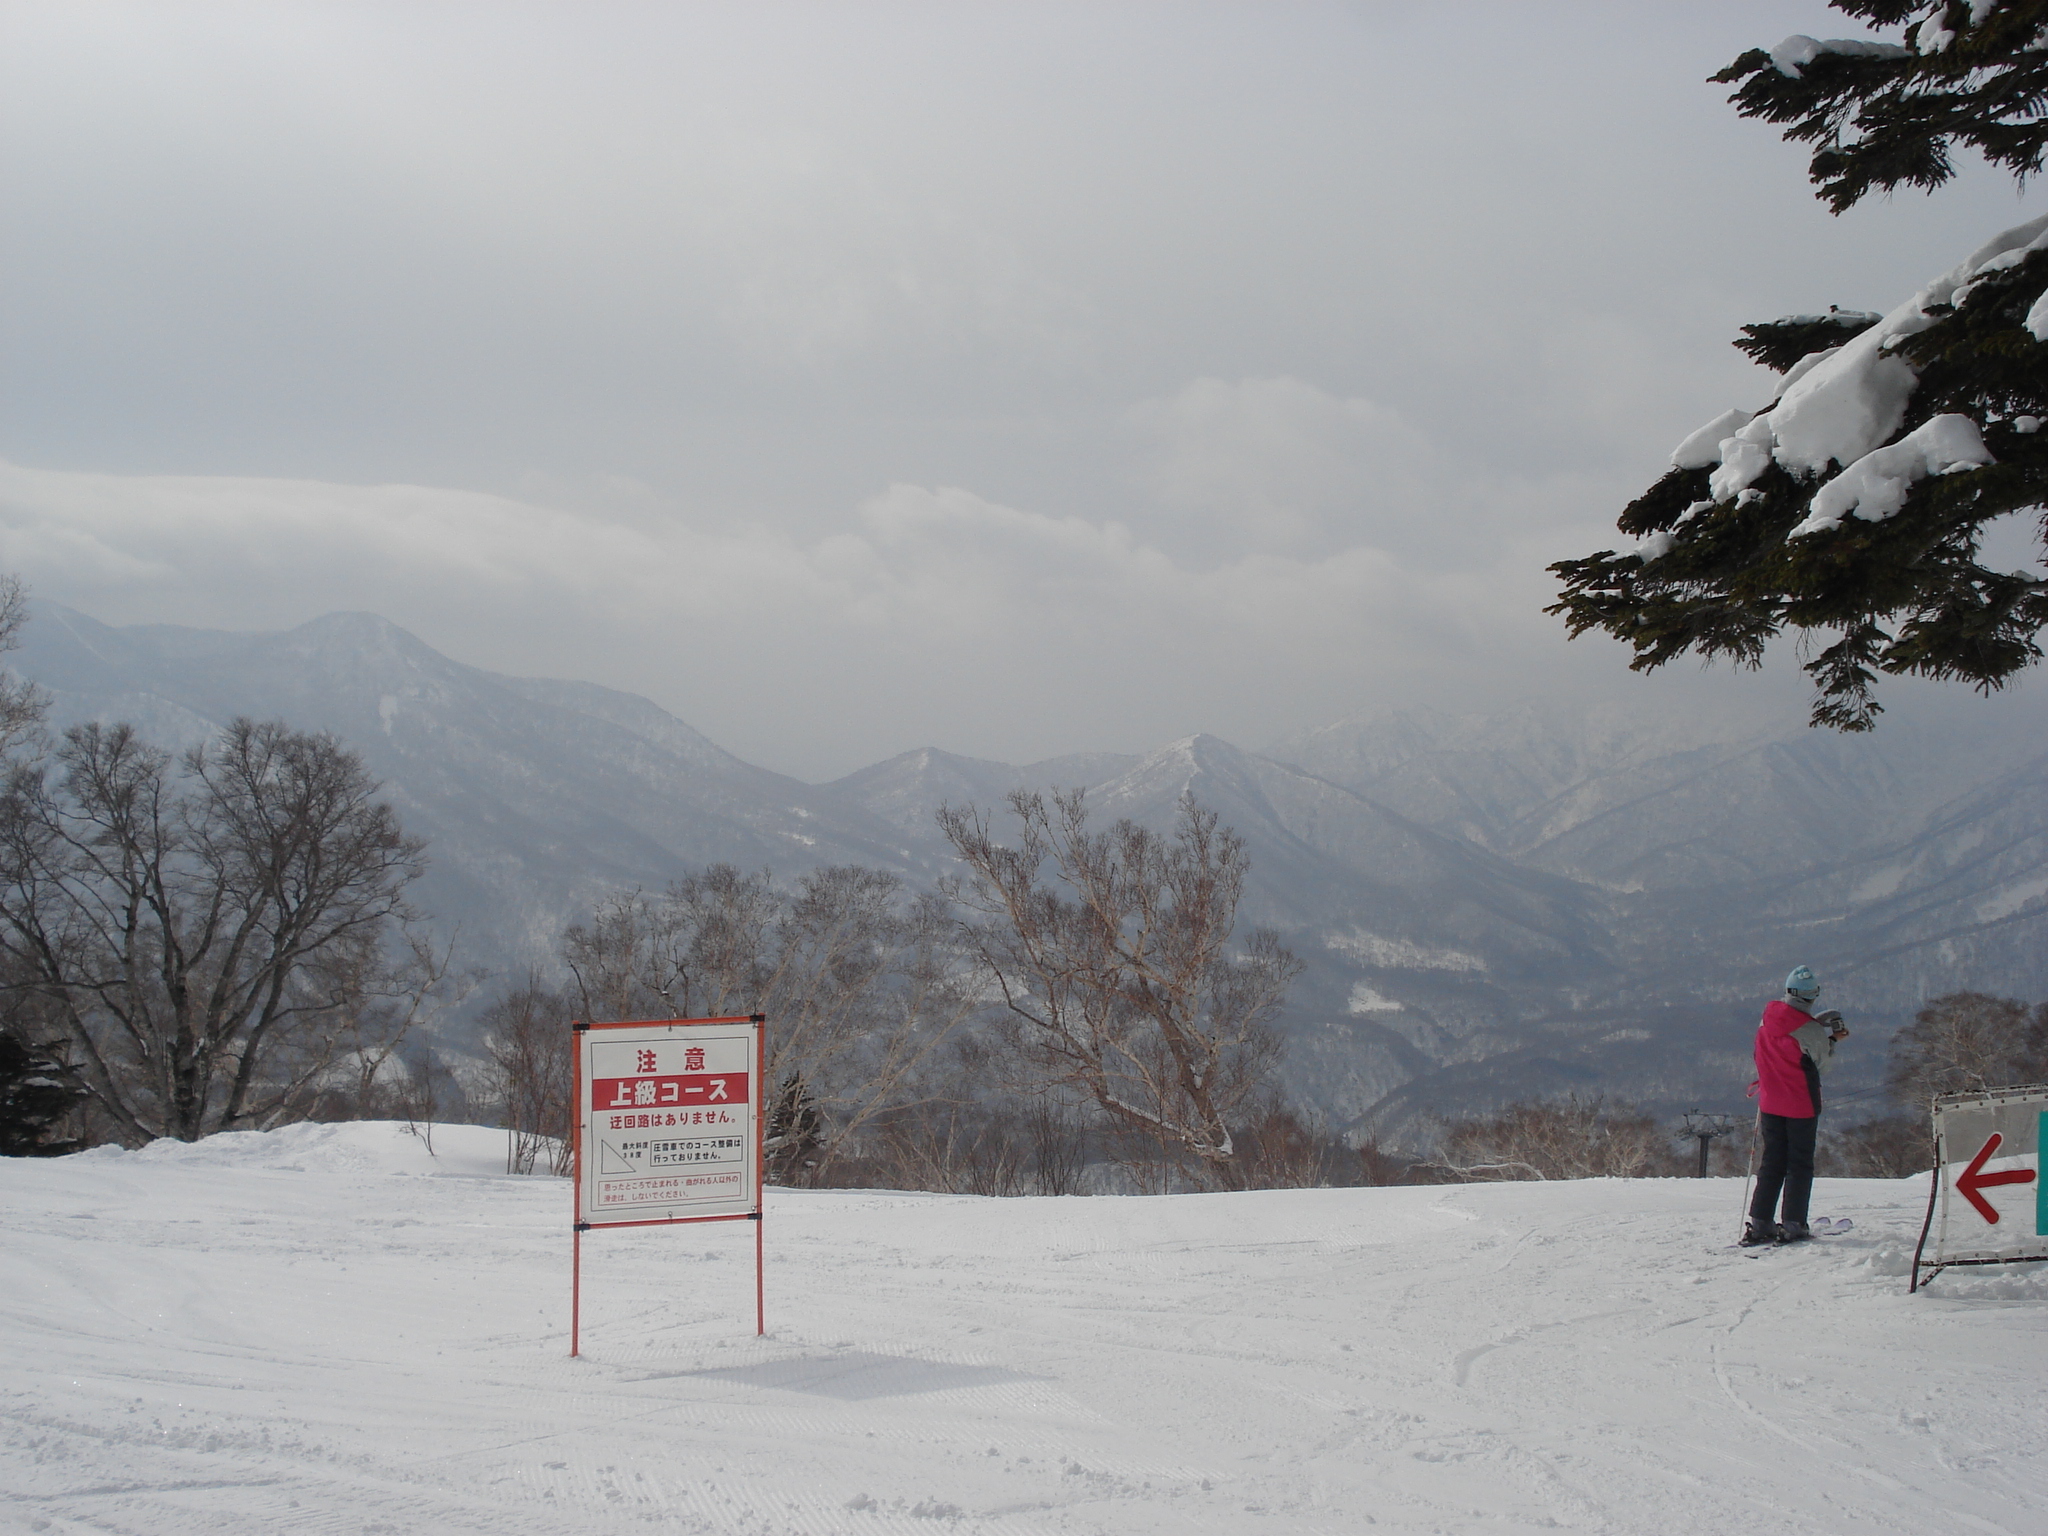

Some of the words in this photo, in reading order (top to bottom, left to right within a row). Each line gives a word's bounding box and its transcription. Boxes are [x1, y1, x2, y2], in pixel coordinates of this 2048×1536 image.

[609, 1079, 729, 1107] 上級コース
[609, 1110, 737, 1130] 迂回路はありません。
[653, 1151, 721, 1163] 行っておりません。
